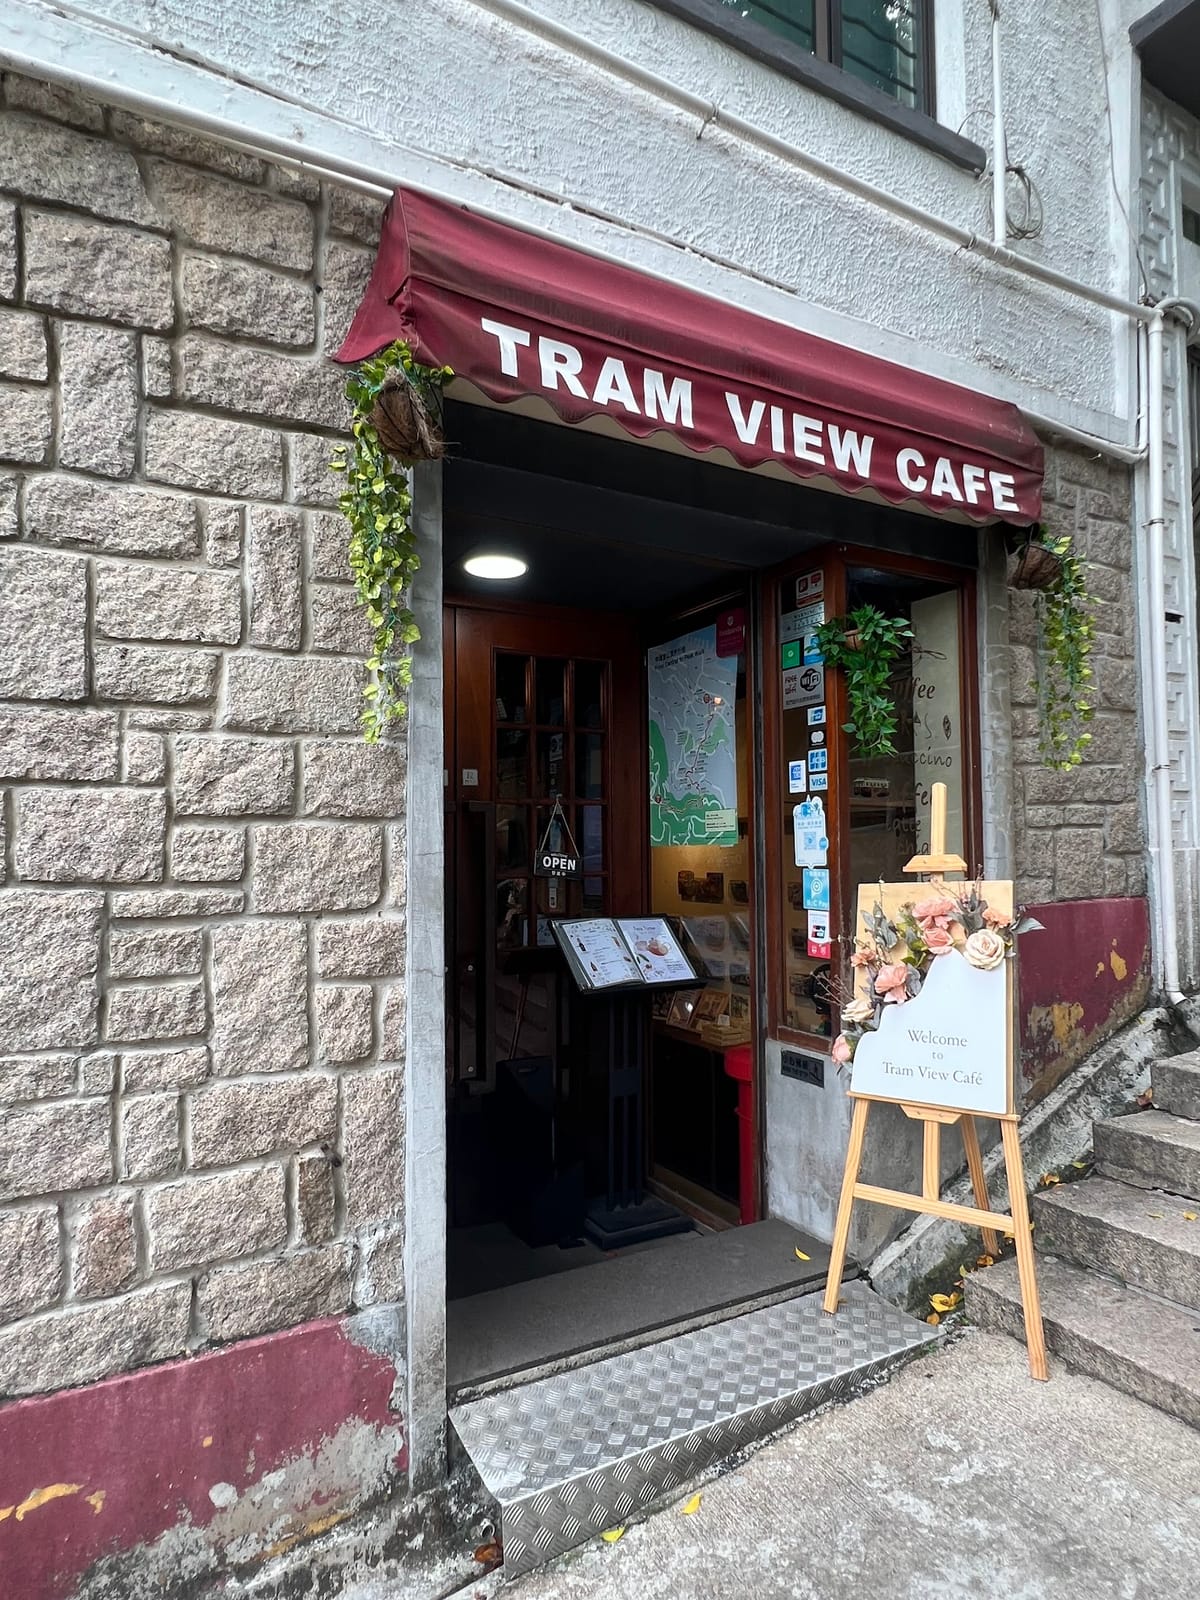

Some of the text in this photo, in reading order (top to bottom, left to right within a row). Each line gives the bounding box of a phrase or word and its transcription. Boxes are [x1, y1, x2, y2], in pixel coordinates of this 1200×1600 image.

[481, 317, 1020, 513] TRAM VIEW CAFE
[811, 778, 826, 787] VISA
[542, 855, 576, 871] OPEN
[908, 1029, 968, 1047] Welcome
[932, 1051, 944, 1060] to
[882, 1061, 983, 1085] Tram View Café
